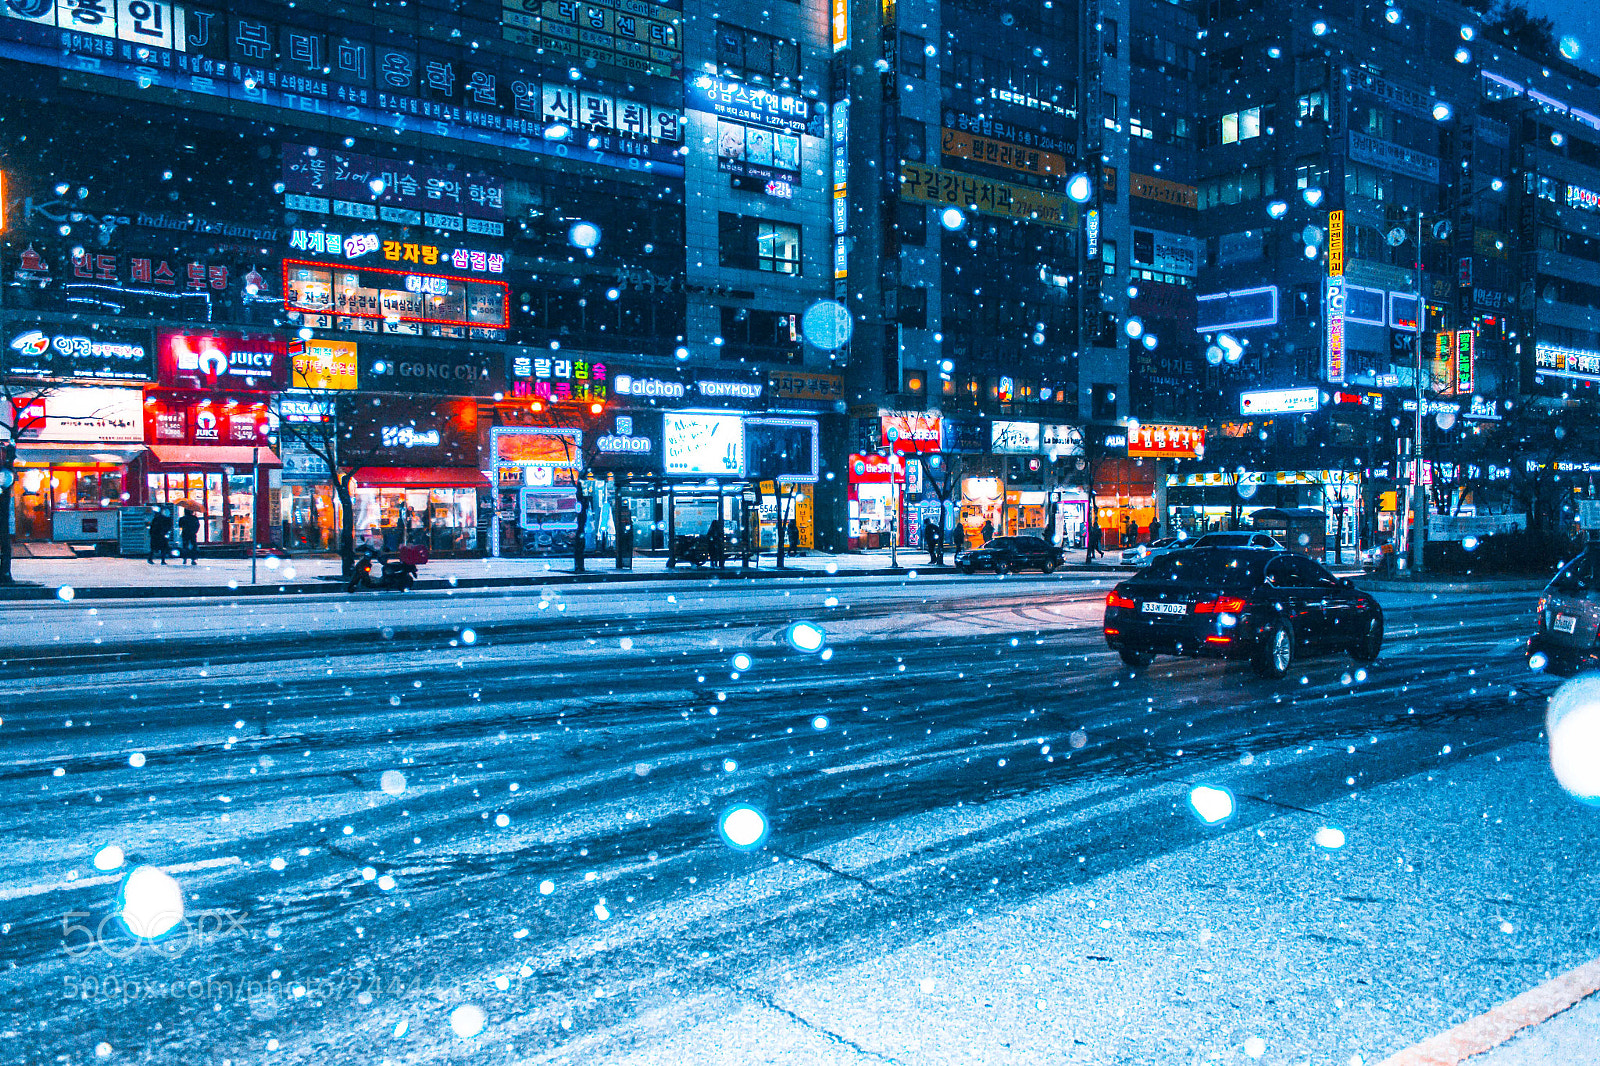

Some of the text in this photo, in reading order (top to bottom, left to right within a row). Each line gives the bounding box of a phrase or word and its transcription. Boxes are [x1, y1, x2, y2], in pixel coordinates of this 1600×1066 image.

[283, 94, 328, 114] TEL
[289, 229, 343, 255] 사계절
[381, 240, 440, 265] 감자탕
[451, 248, 505, 273] 삼겹살
[229, 351, 274, 367] JUICY
[513, 356, 572, 379] 훌랄라
[399, 361, 491, 381] GONG CHA
[699, 381, 762, 397] TONYMOLY
[195, 428, 219, 437] JUICY
[1163, 604, 1183, 614] 7002
